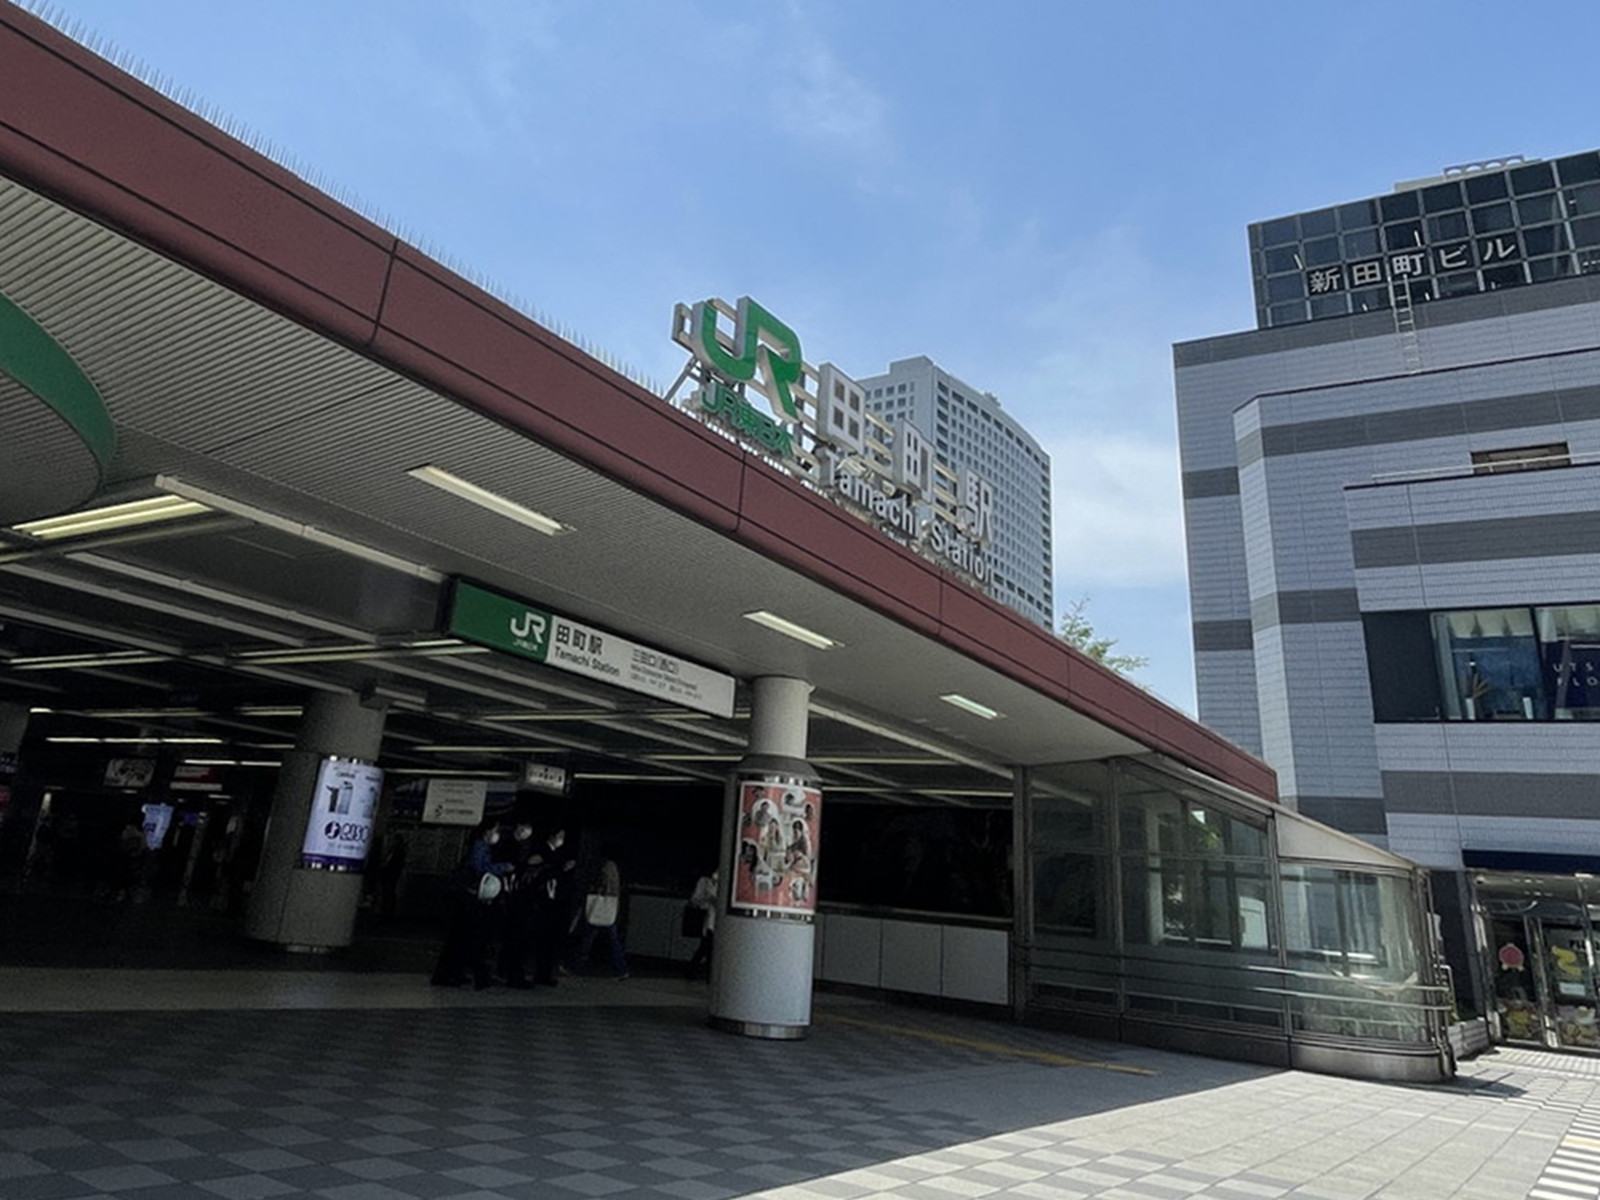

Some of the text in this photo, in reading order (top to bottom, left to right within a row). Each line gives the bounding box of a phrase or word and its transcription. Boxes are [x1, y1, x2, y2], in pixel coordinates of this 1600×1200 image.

[1309, 237, 1516, 293] 新田町ビル
[695, 295, 804, 422] JR
[819, 361, 995, 549] 田町駅
[826, 450, 994, 586] Tamachi Station
[510, 611, 546, 644] JR
[556, 623, 603, 656] 田町駅
[554, 645, 591, 669] Tamachi
[592, 657, 620, 677] Station
